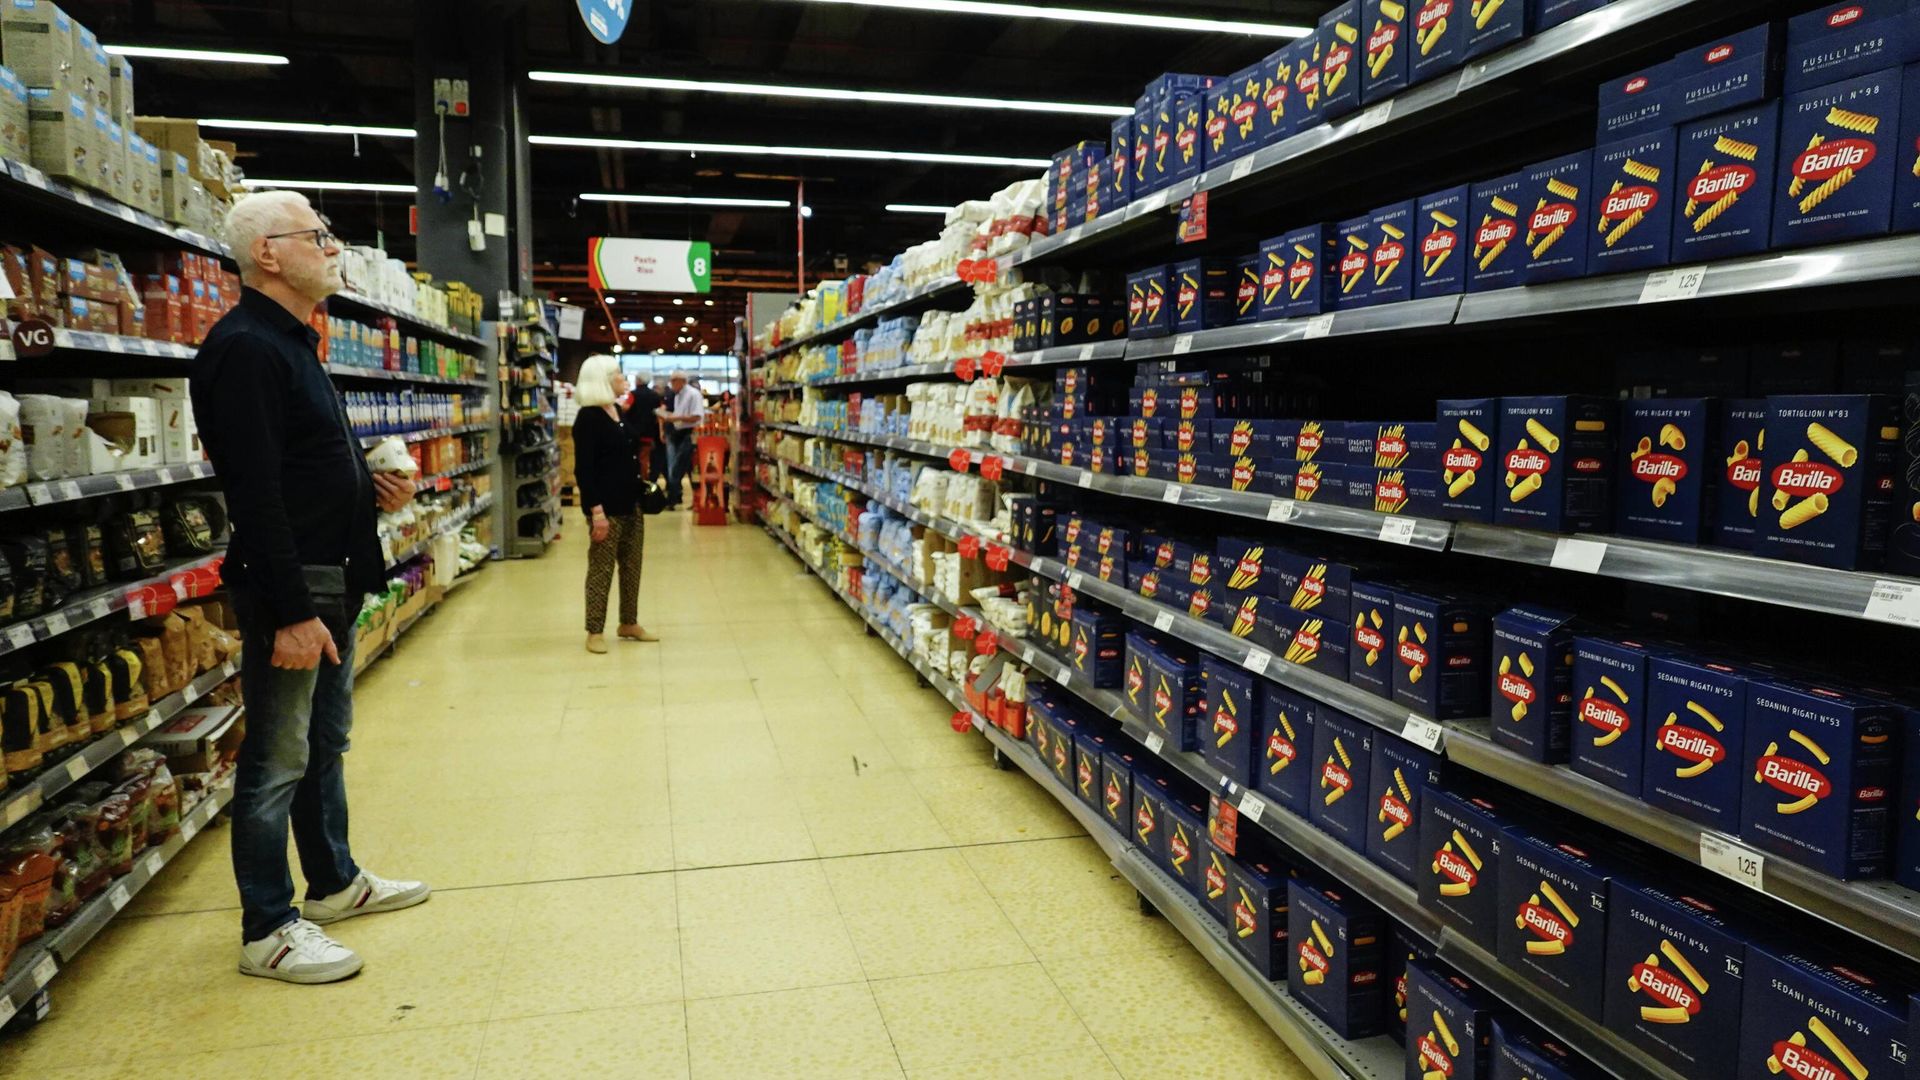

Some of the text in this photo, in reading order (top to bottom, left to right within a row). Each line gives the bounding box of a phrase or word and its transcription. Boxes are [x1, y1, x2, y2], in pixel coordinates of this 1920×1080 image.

[1419, 3, 1449, 27] Barilla
[1831, 10, 1858, 24] Barilla
[1370, 30, 1395, 53] Barilla
[1802, 38, 1884, 69] FUSILLI N°98
[1686, 82, 1720, 99] FUSILLI
[1799, 85, 1880, 113] FUSILLI N°98
[1608, 111, 1637, 126] FUSILLI
[1692, 116, 1759, 140] FUSILLI N°98
[1604, 148, 1636, 162] FUSILLI
[1801, 146, 1863, 173] Barilla
[1694, 172, 1745, 195] Barilla
[1606, 192, 1649, 213] Barilla
[1533, 209, 1569, 228] Barilla
[1480, 225, 1511, 242] Barilla
[1425, 236, 1452, 252] Barilla
[1343, 257, 1365, 271] Barilla
[1376, 247, 1400, 262] Barilla
[694, 258, 706, 276] 8
[1678, 273, 1700, 289] 1.25
[18, 329, 49, 347] VG
[1778, 410, 1849, 418] TORTIGLIONI N°83
[1300, 437, 1319, 451] Barilla
[1380, 441, 1403, 452] Barilla
[1447, 454, 1476, 467] Barilla
[1509, 455, 1545, 469] Barilla
[1637, 460, 1679, 476] Barilla
[1733, 466, 1760, 481] Bari
[1779, 470, 1832, 488] Barilla
[1379, 486, 1402, 498] Barilla
[1358, 631, 1381, 647] Barilla
[1401, 646, 1425, 663] Barilla
[1578, 650, 1602, 662] SEDANINI
[1602, 657, 1619, 668] RIGATI
[1502, 678, 1531, 699] Barilla
[1658, 672, 1733, 698] SEDANINI RIGATI N°53
[1585, 703, 1622, 726] Barilla
[1756, 698, 1840, 727] SEDANINI RIGATI N°53
[1217, 715, 1235, 730] Barilla
[1271, 739, 1292, 757] Barilla
[1665, 730, 1715, 757] Barilla
[1326, 767, 1348, 786] Barilla
[1765, 761, 1820, 792] Barilla
[1384, 799, 1408, 821] Barilla
[1434, 807, 1451, 822] SEDANI
[1452, 817, 1468, 832] RIGATI
[1440, 854, 1472, 881] Barilla
[1516, 855, 1538, 872] SEDANI
[1539, 866, 1560, 882] RIGATI
[1738, 856, 1756, 877] 1.25
[1526, 908, 1567, 939] Barilla
[1630, 908, 1658, 928] SEDANI
[1660, 922, 1686, 942] RIGATI
[1302, 946, 1326, 969] Barilla
[1725, 959, 1739, 974] 1Kg
[1640, 969, 1690, 1007] Barilla
[1771, 978, 1870, 1036] SEDANI RIGATI N°94
[1422, 1040, 1449, 1071] Barilla
[1890, 1043, 1908, 1062] 1Kg
[1782, 1048, 1836, 1080] Barill
